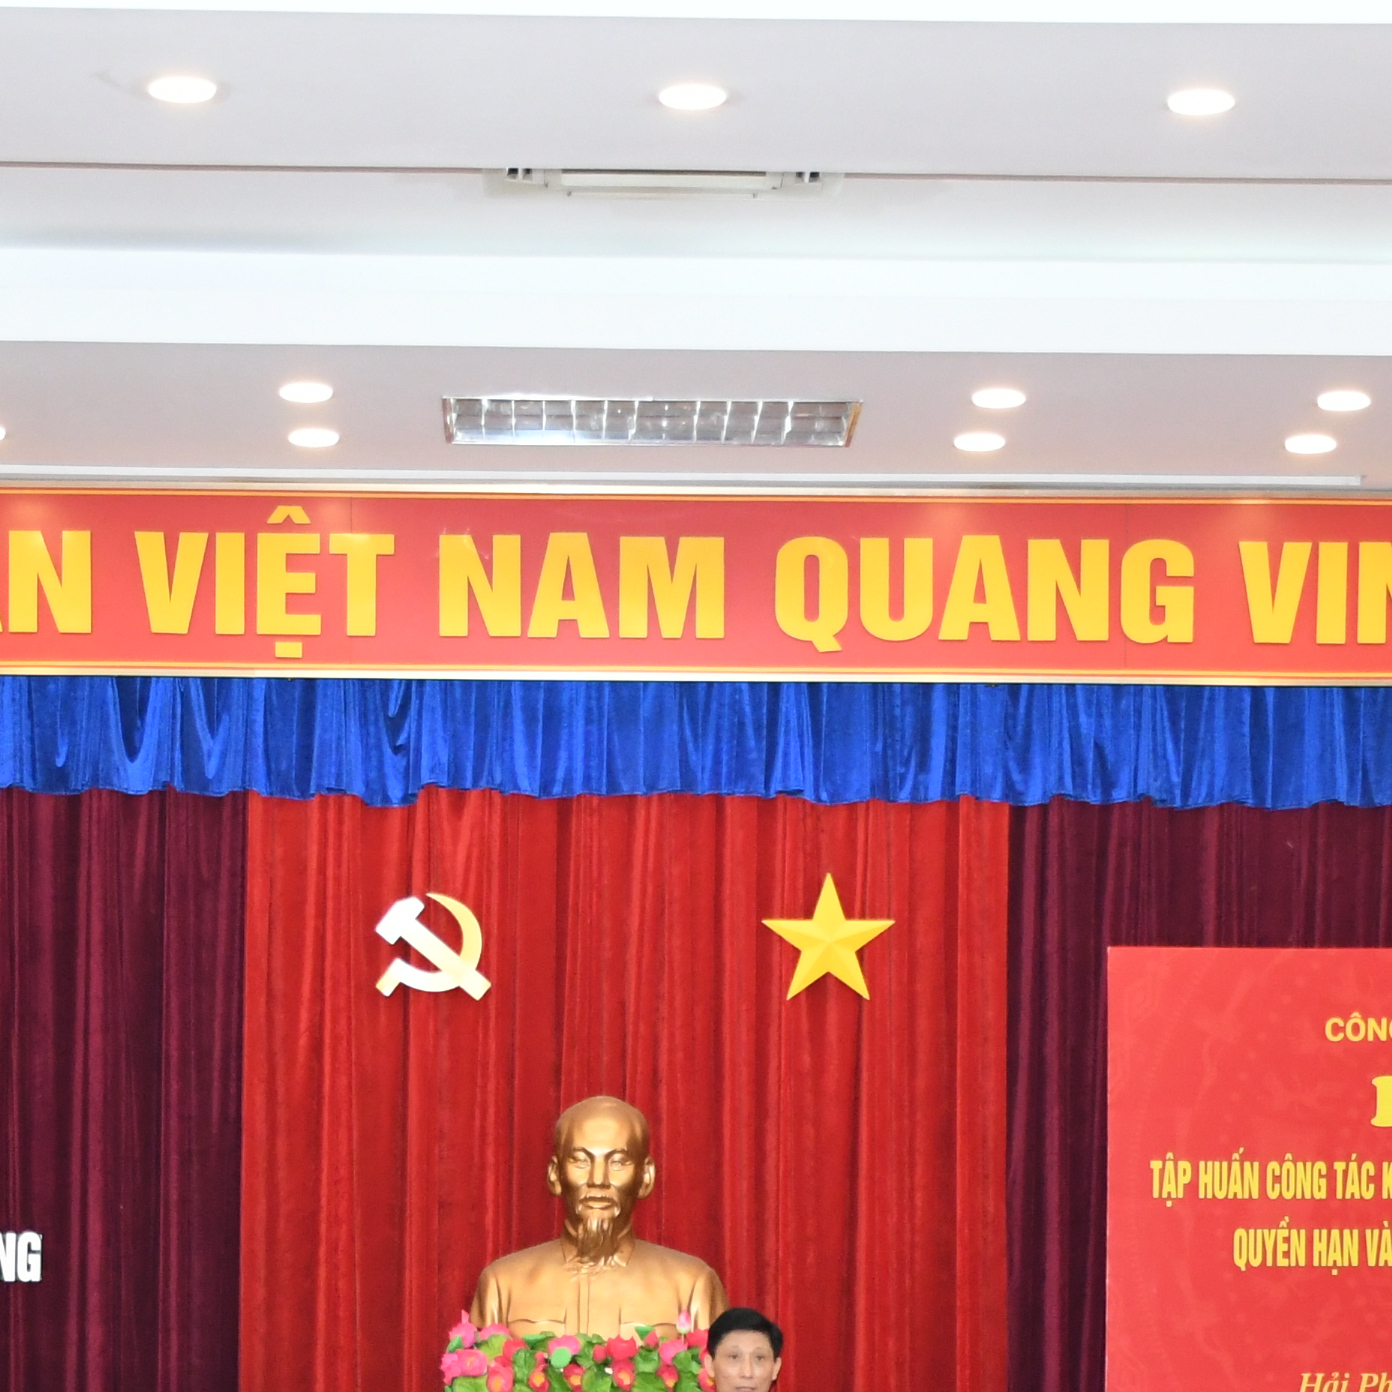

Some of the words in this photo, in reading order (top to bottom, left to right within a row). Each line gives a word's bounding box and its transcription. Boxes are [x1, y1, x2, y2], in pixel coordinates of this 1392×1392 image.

[134, 505, 395, 658] VIỆT
[439, 531, 725, 640] NAM
[774, 534, 1195, 653] QUANG
[1150, 1152, 1192, 1207] TẬP
[1199, 1148, 1259, 1199] HUẤN
[1266, 1153, 1326, 1199] CÔNG
[1334, 1154, 1374, 1199] TÁC
[1234, 1216, 1306, 1271] QUYỀN
[1313, 1229, 1358, 1275] HẠN
